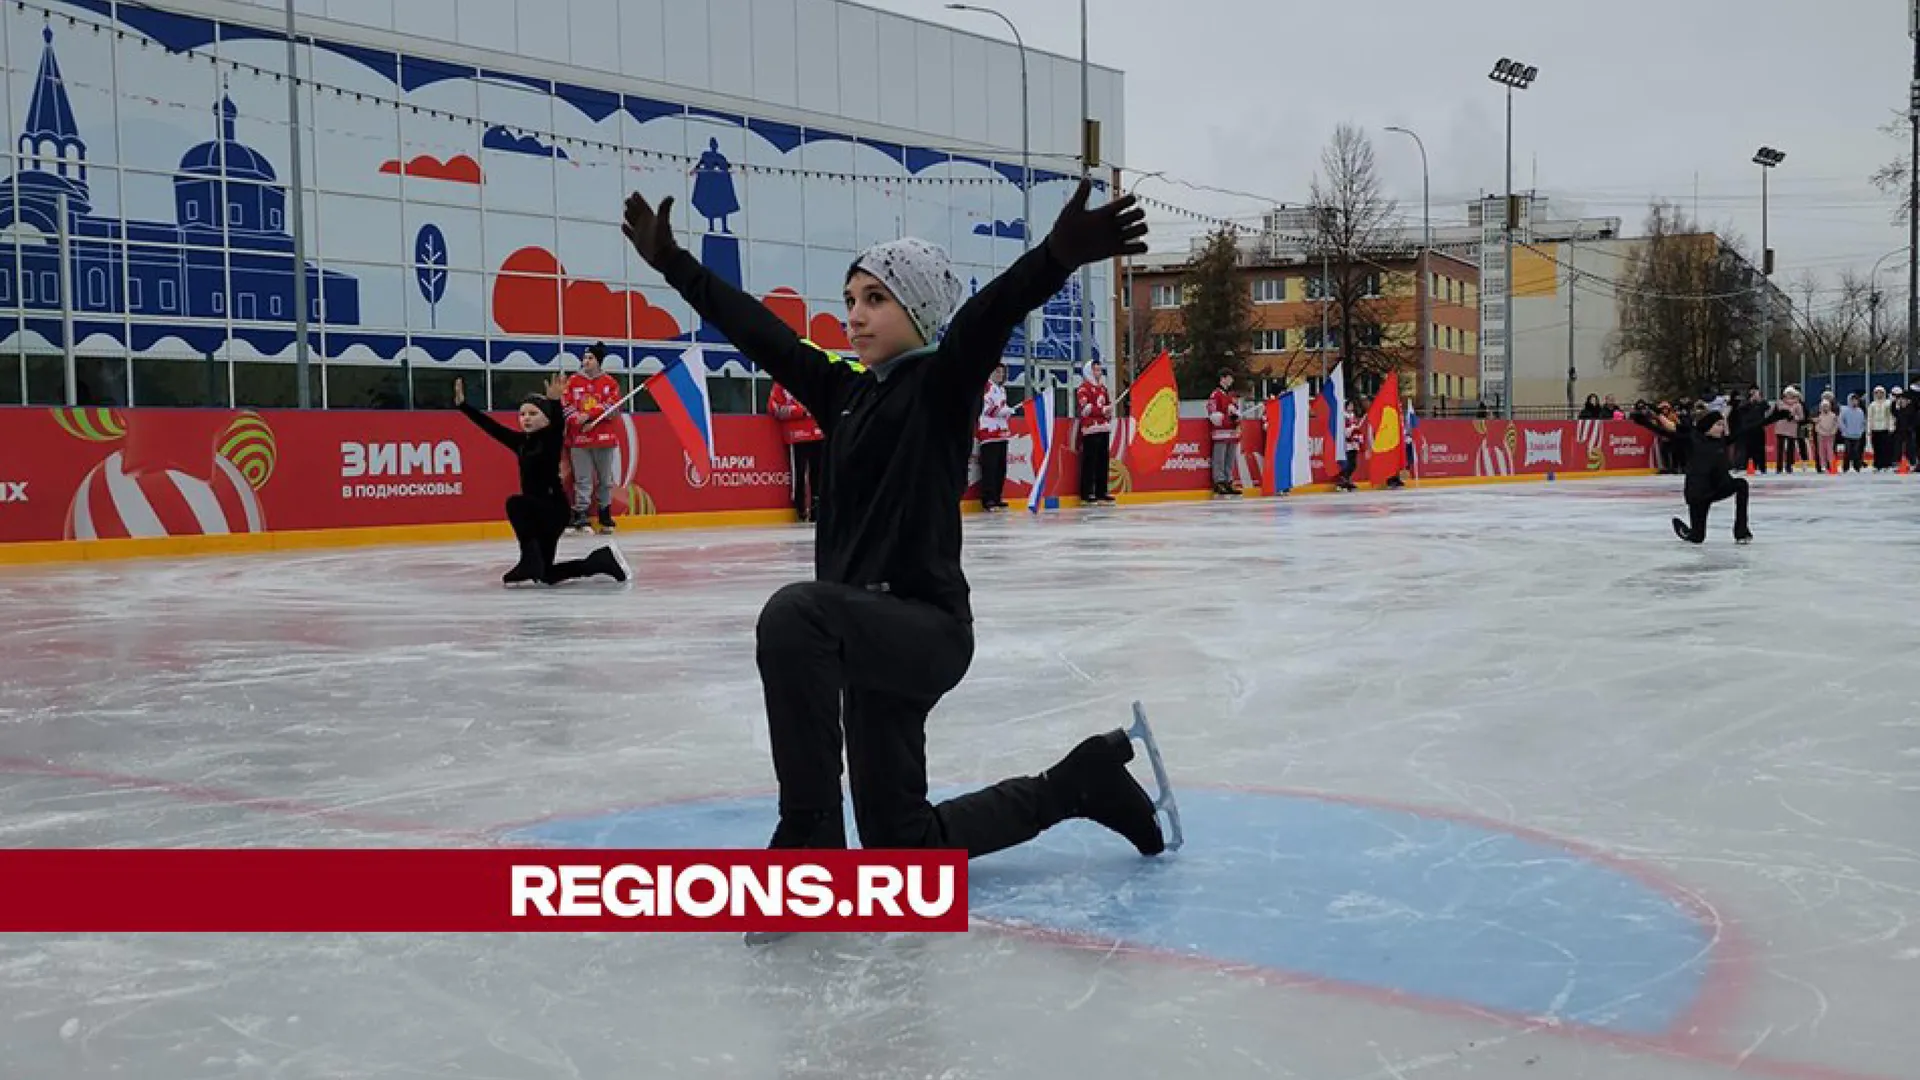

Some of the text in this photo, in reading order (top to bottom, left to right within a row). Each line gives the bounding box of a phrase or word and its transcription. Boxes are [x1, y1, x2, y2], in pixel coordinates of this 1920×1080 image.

[341, 441, 462, 476] ЗИМА
[711, 455, 755, 469] ПАРКИ
[355, 482, 463, 499] ПОДМОСКОВЬЕ
